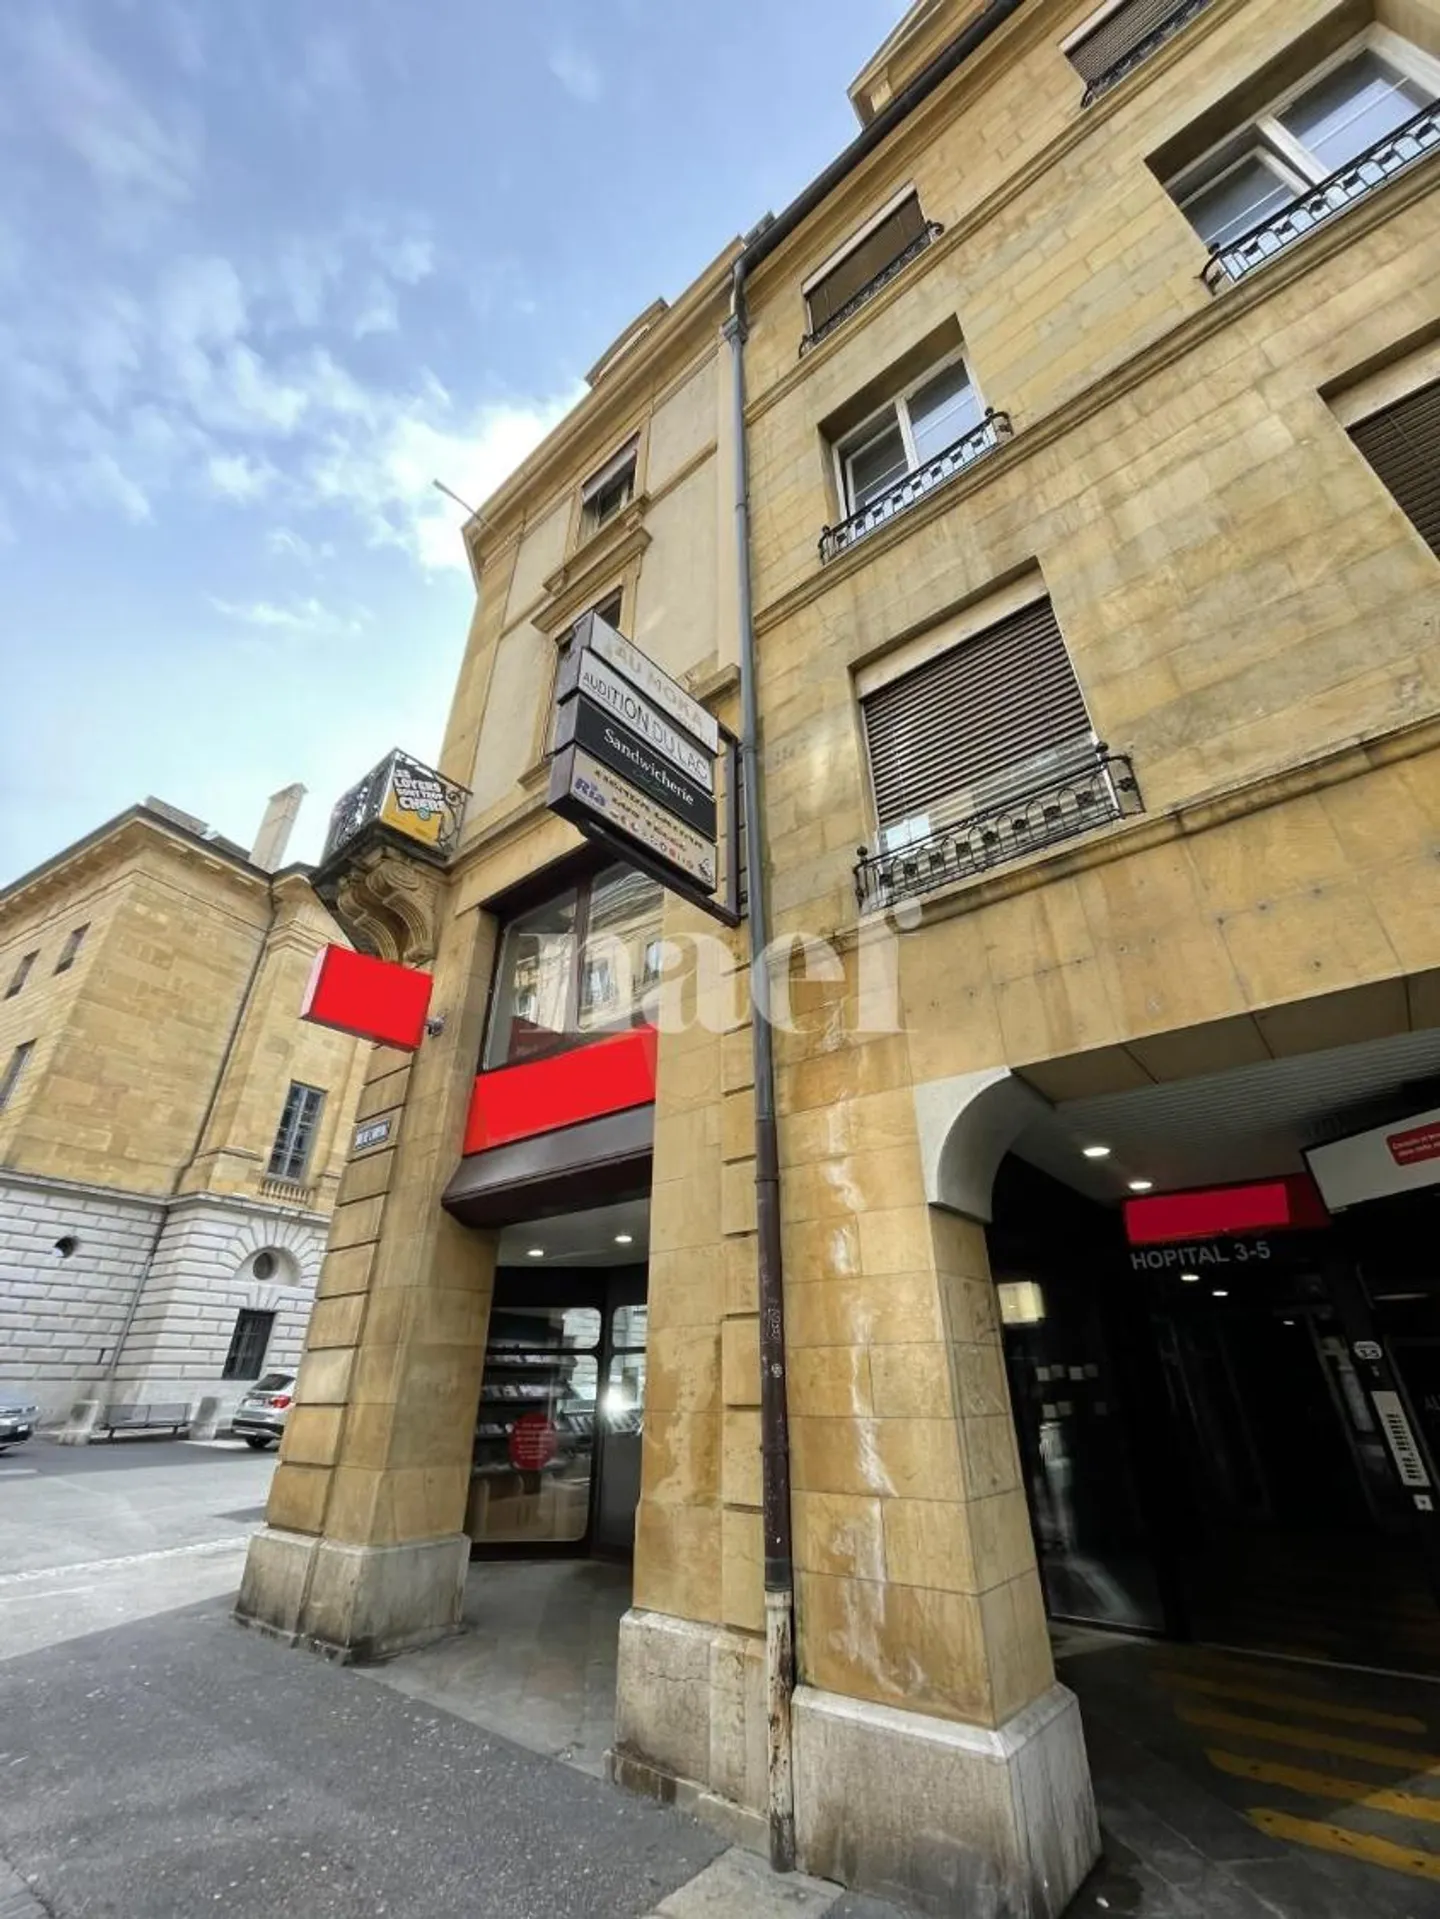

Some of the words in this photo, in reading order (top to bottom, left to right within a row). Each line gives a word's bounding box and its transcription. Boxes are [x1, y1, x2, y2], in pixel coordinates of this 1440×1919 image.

[582, 671, 648, 732] AUDITION
[650, 715, 675, 753] DU
[574, 776, 606, 807] Ria
[604, 728, 694, 804] Sandwicherie
[1131, 1244, 1230, 1270] HOPITAL
[1233, 1240, 1271, 1261] 3-5
